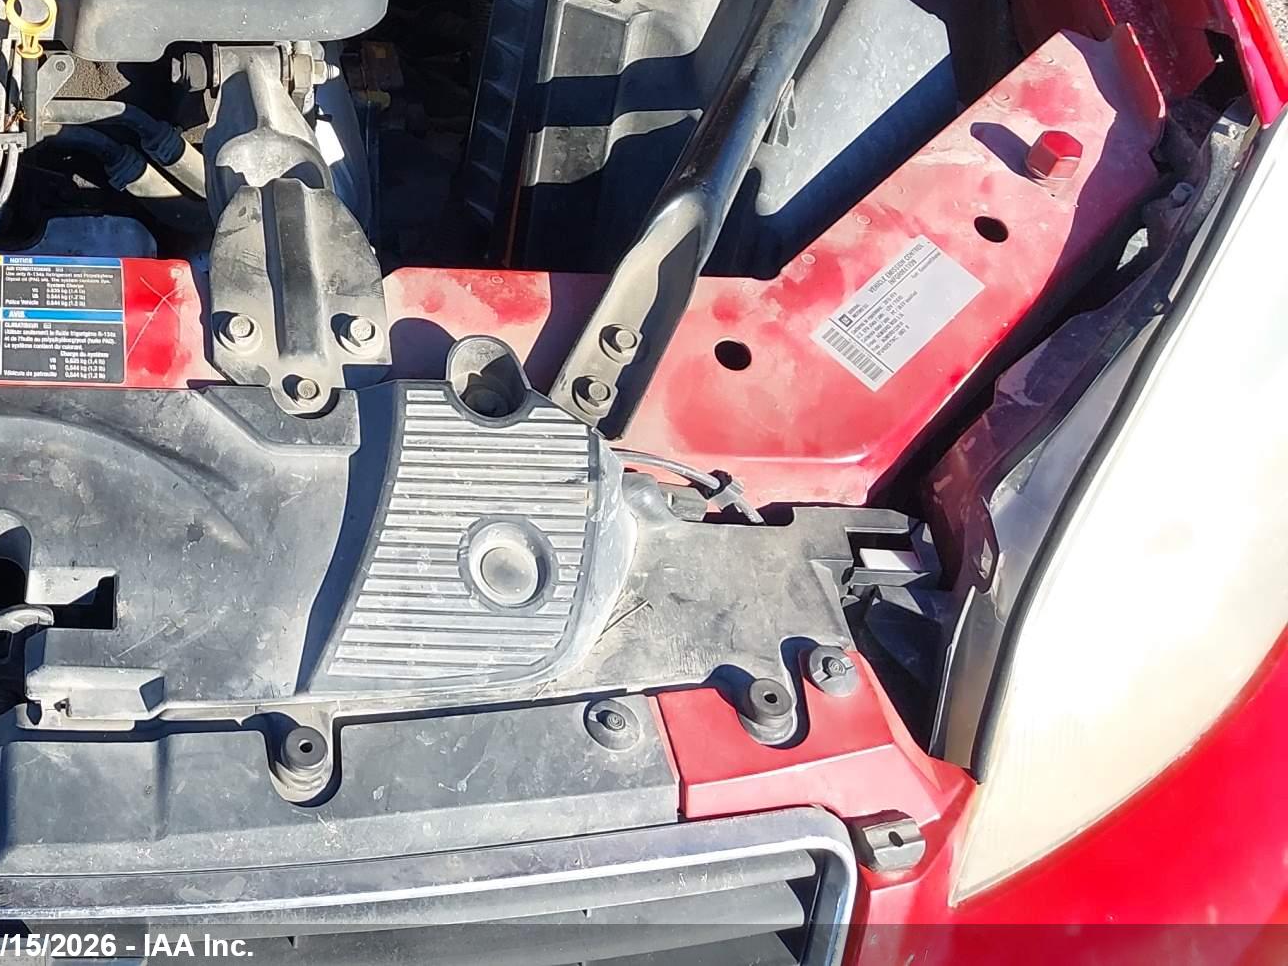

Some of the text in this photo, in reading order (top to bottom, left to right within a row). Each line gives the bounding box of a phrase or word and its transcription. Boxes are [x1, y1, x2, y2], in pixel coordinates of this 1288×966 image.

[869, 244, 924, 294] VEHICLE EMISSION CONTROL
